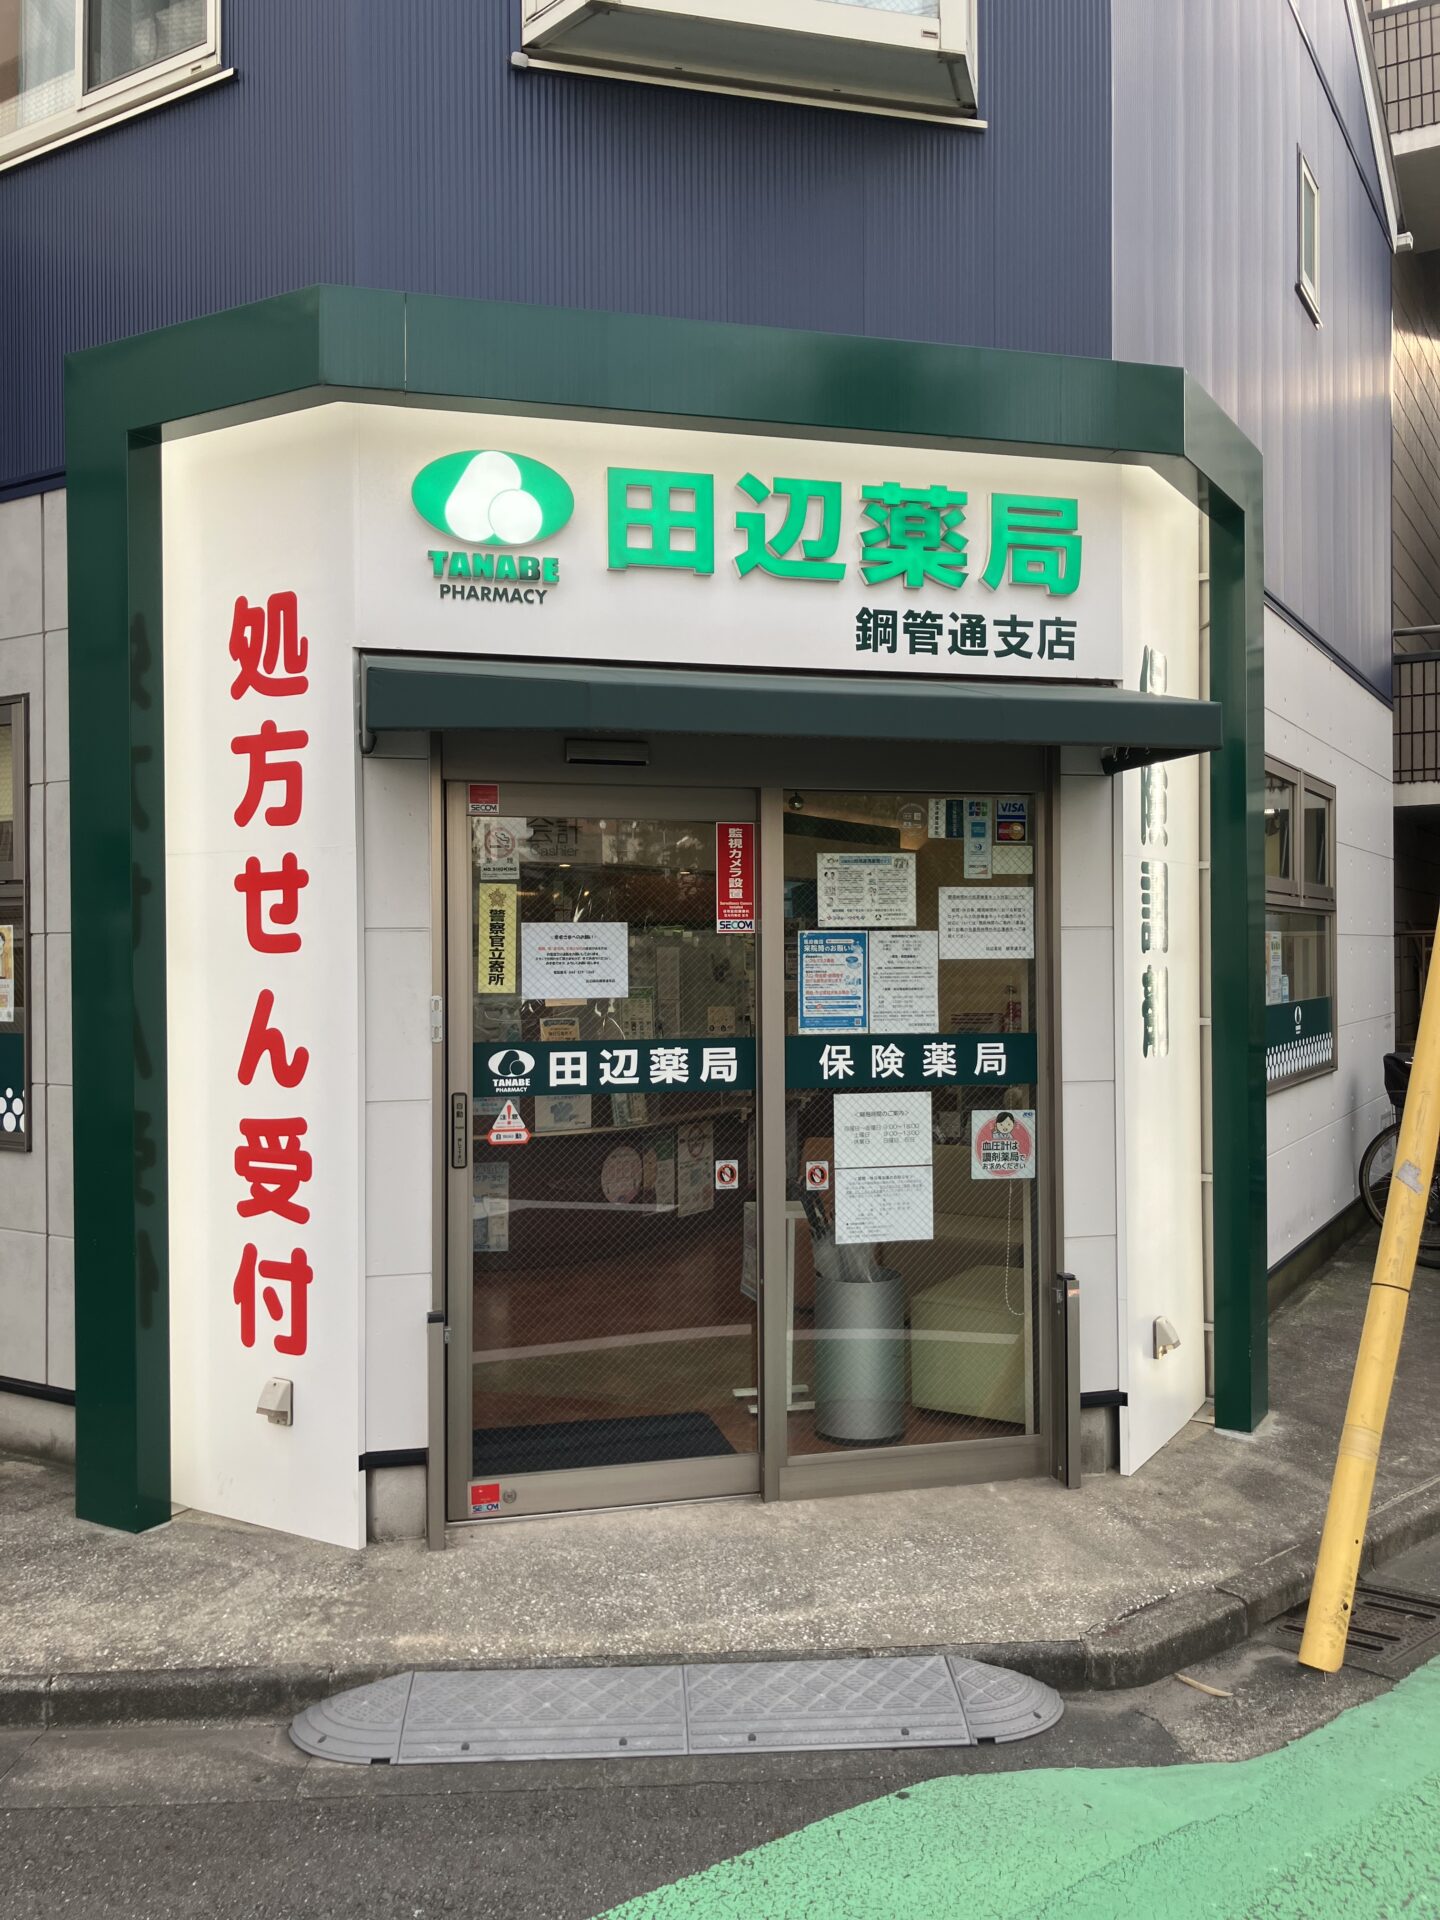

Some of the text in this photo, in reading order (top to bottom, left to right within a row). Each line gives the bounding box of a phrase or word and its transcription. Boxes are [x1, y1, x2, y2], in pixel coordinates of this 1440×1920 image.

[606, 466, 1084, 597] 田辺薬局
[428, 550, 560, 583] TANABE
[439, 584, 548, 605] PHARMACY
[855, 606, 1078, 661] 鋼管通支店
[470, 803, 498, 812] SECOM
[1001, 803, 1025, 813] VISA
[728, 826, 743, 899] 監視カメラ設置
[719, 920, 753, 930] SECOM
[488, 908, 506, 986] 警察官立寄所
[229, 590, 313, 1357] 処方せん受付
[549, 1047, 738, 1086] 田辺薬局
[819, 1042, 1007, 1080] 保険薬局
[492, 1078, 531, 1087] TANABE
[983, 1141, 1018, 1151] 血圧計は
[983, 1152, 1026, 1162] 調剤薬局で
[472, 1503, 499, 1513] SECOM
